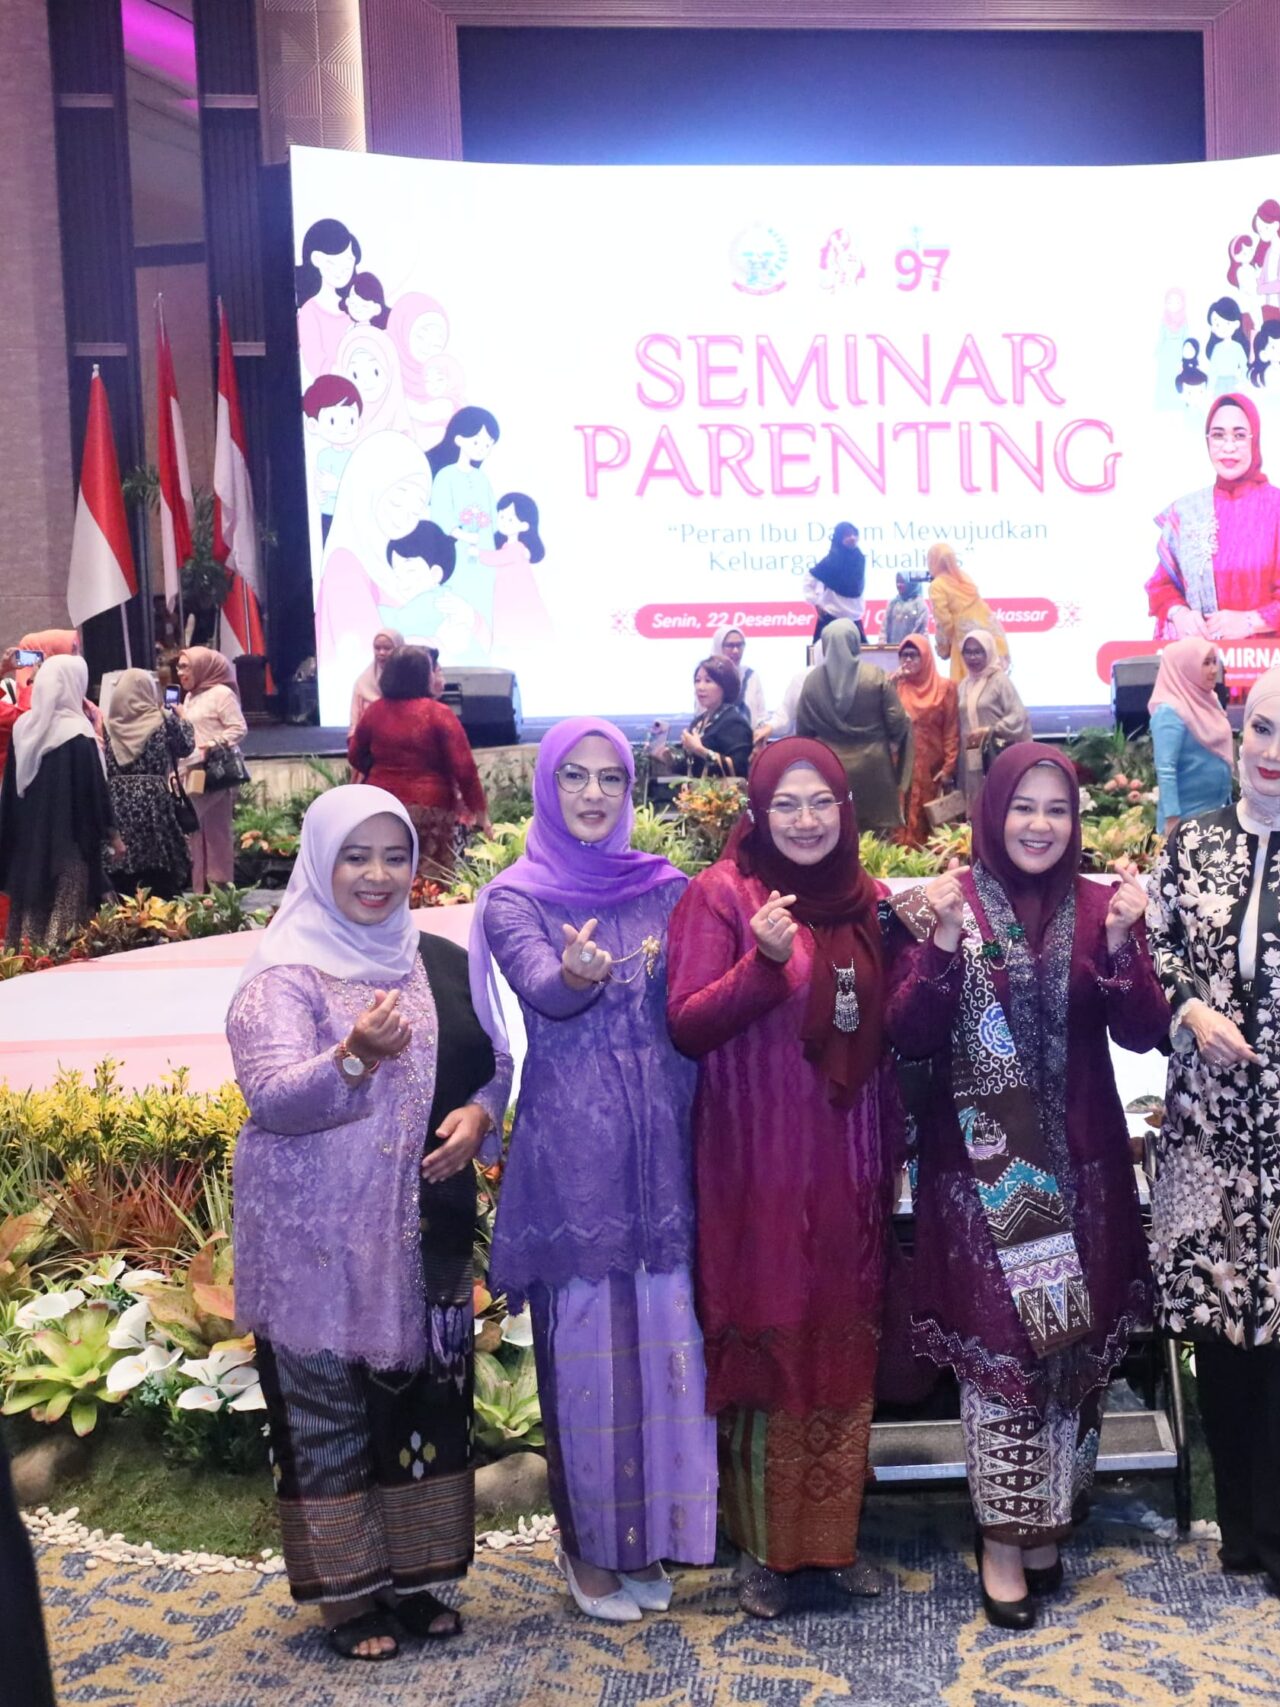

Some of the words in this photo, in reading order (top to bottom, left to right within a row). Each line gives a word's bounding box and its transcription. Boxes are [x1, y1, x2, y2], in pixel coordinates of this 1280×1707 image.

[894, 248, 950, 292] 97
[635, 332, 1067, 411] SEMINAR
[573, 417, 1123, 499] PARENTING
[761, 523, 797, 542] Ibu
[893, 519, 1047, 545] Mewujudkan
[709, 550, 817, 576] Keluarga
[651, 612, 702, 630] Senin,
[706, 611, 730, 628] 22
[732, 610, 815, 628] Desember
[994, 607, 1049, 622] kassar
